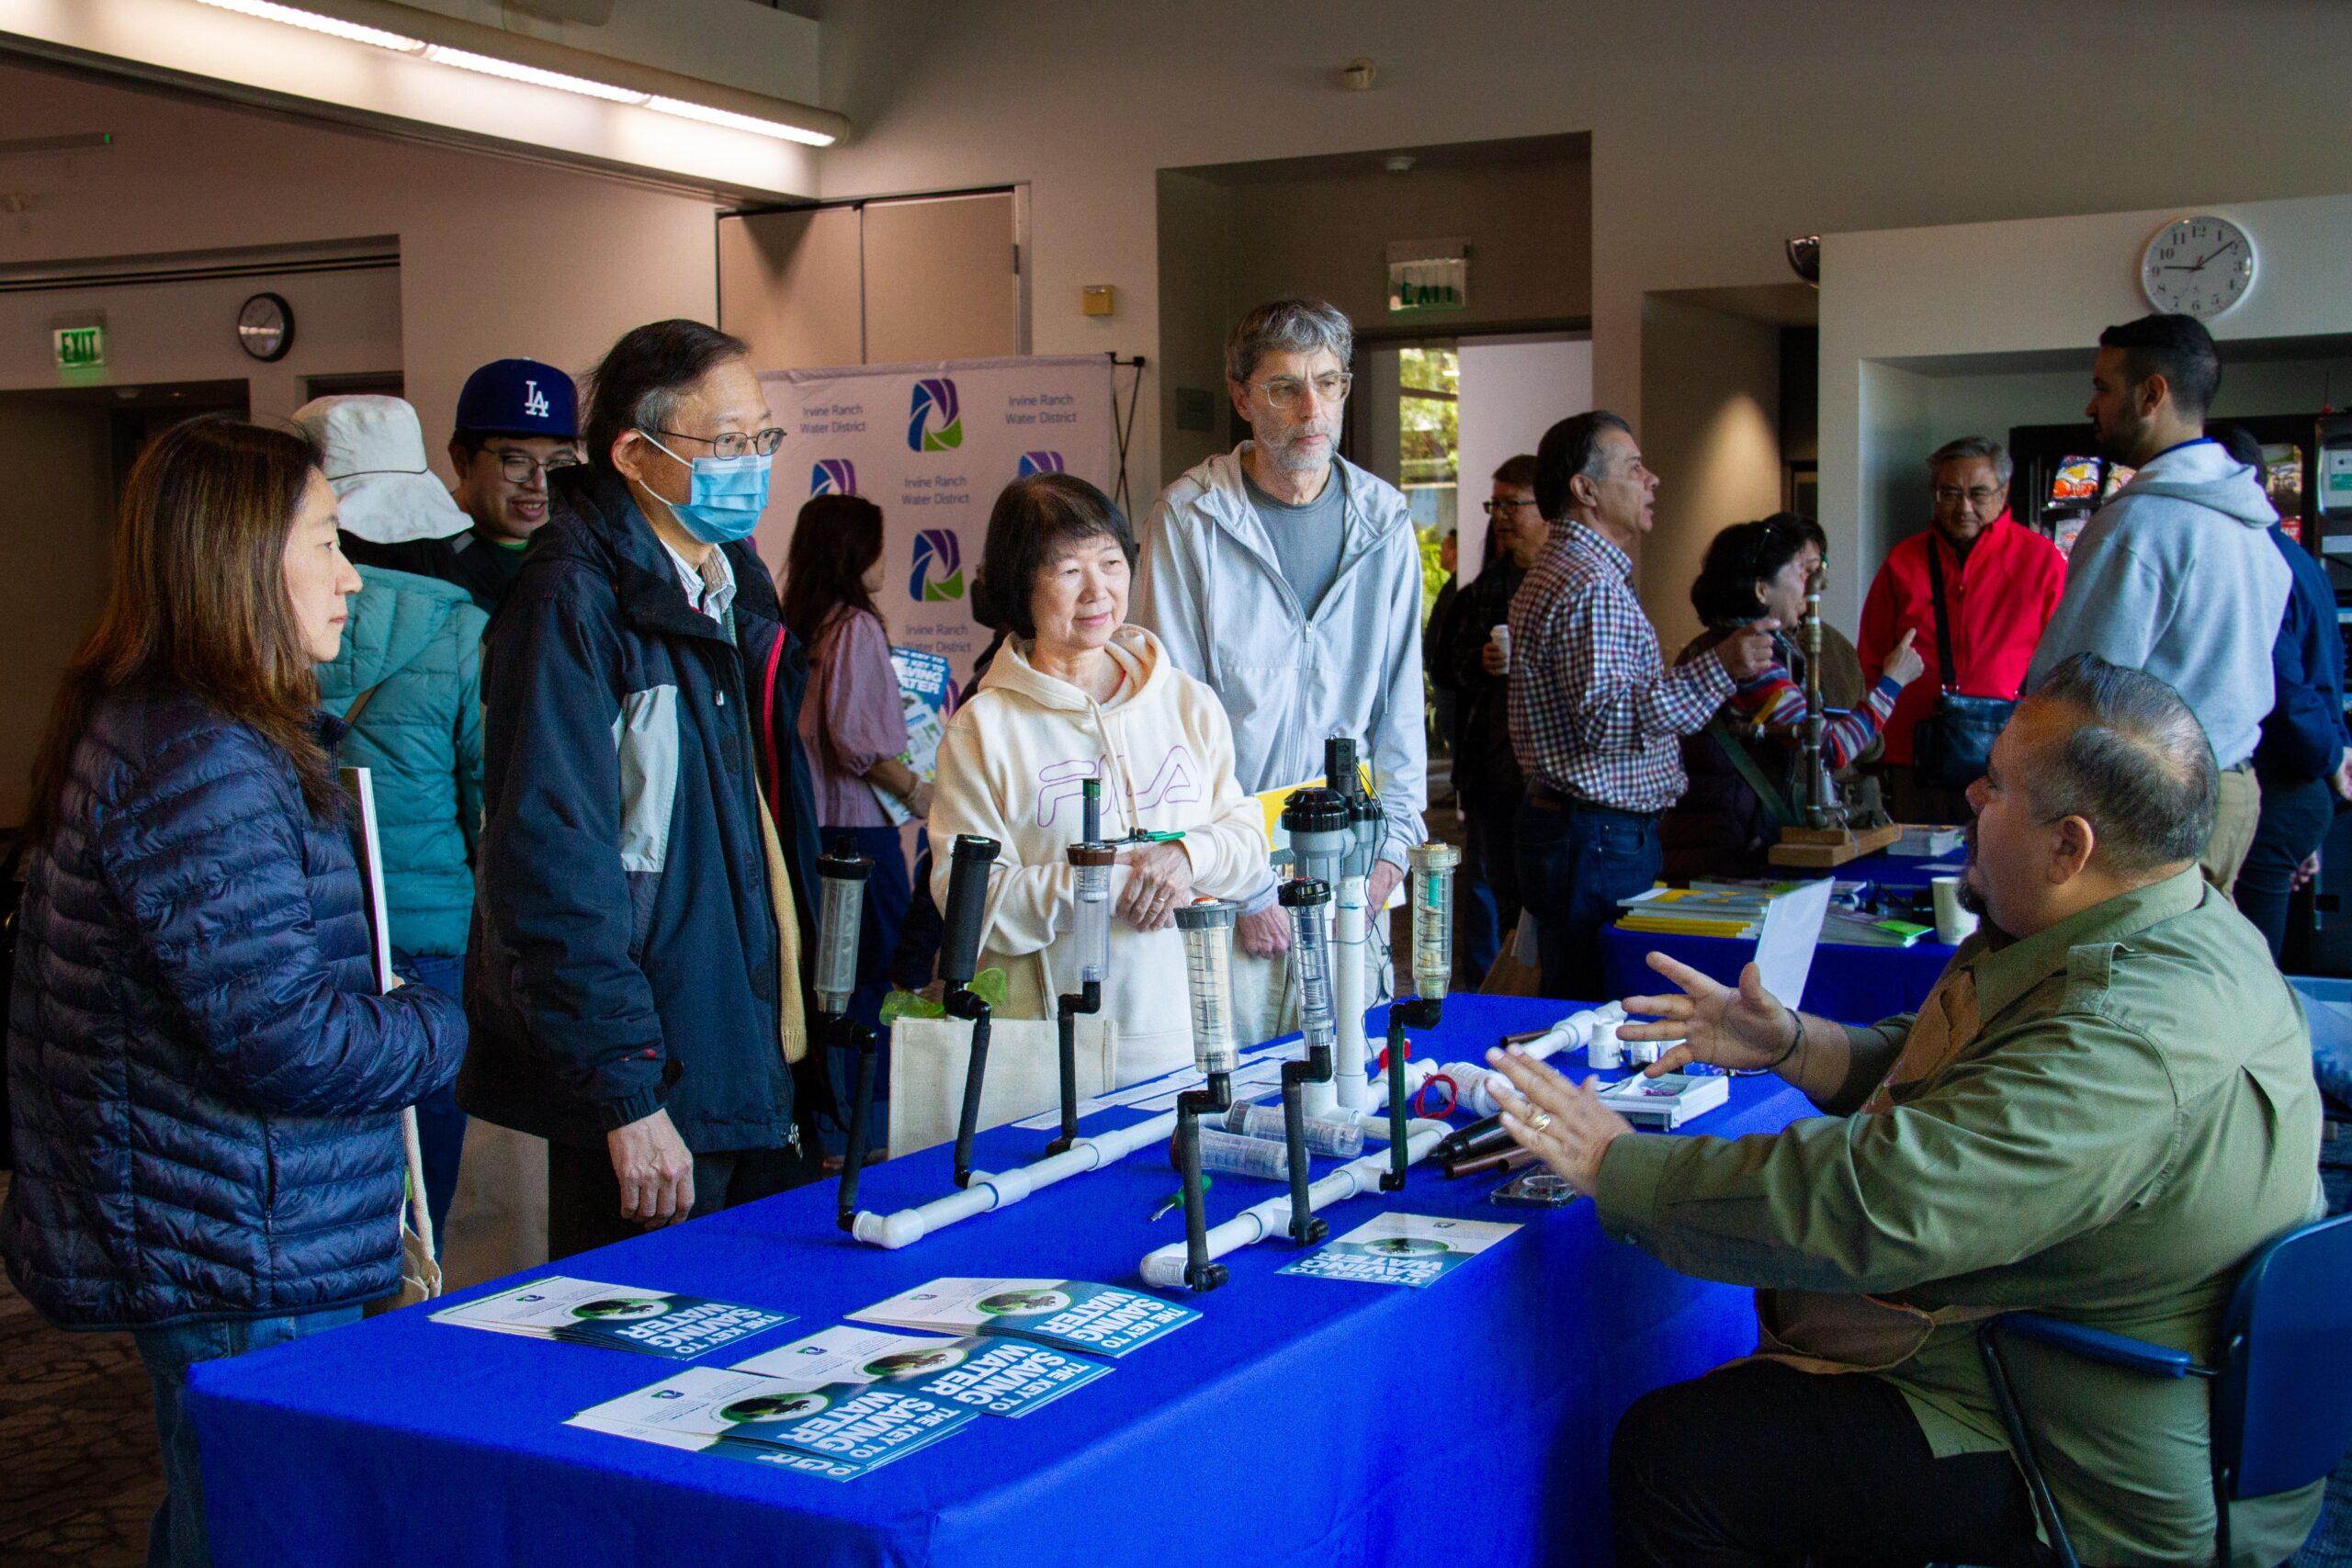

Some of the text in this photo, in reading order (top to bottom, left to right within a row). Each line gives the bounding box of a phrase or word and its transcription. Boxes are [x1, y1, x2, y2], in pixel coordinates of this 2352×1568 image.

[61, 330, 96, 364] EXIT
[525, 380, 549, 418] LA
[802, 403, 863, 417] Irvine Ranch
[1005, 411, 1077, 424] Water District
[1009, 392, 1073, 407] Irvine Ranch
[799, 421, 866, 434] Water District
[901, 492, 971, 505] Water District
[904, 474, 967, 488] Irvine Ranch
[936, 624, 969, 636] Ranch
[1289, 1267, 1421, 1284] THE KEY TO
[1300, 1259, 1437, 1278] SAVING
[1313, 1251, 1443, 1271] WATER
[615, 1303, 737, 1339] WATER
[643, 1308, 762, 1348] SAVING
[1034, 1291, 1137, 1334] WATER
[1065, 1298, 1165, 1342] SAVING
[1101, 1308, 1188, 1348] THE KEY TO
[674, 1314, 785, 1354] THE KEY TO
[919, 1344, 1038, 1396] WATER
[952, 1351, 1066, 1405] SAVING
[989, 1362, 1091, 1411] THE KEY TO
[776, 1391, 906, 1443] WATER
[812, 1397, 935, 1451] SAVING
[849, 1407, 961, 1459] THE KEY TO
